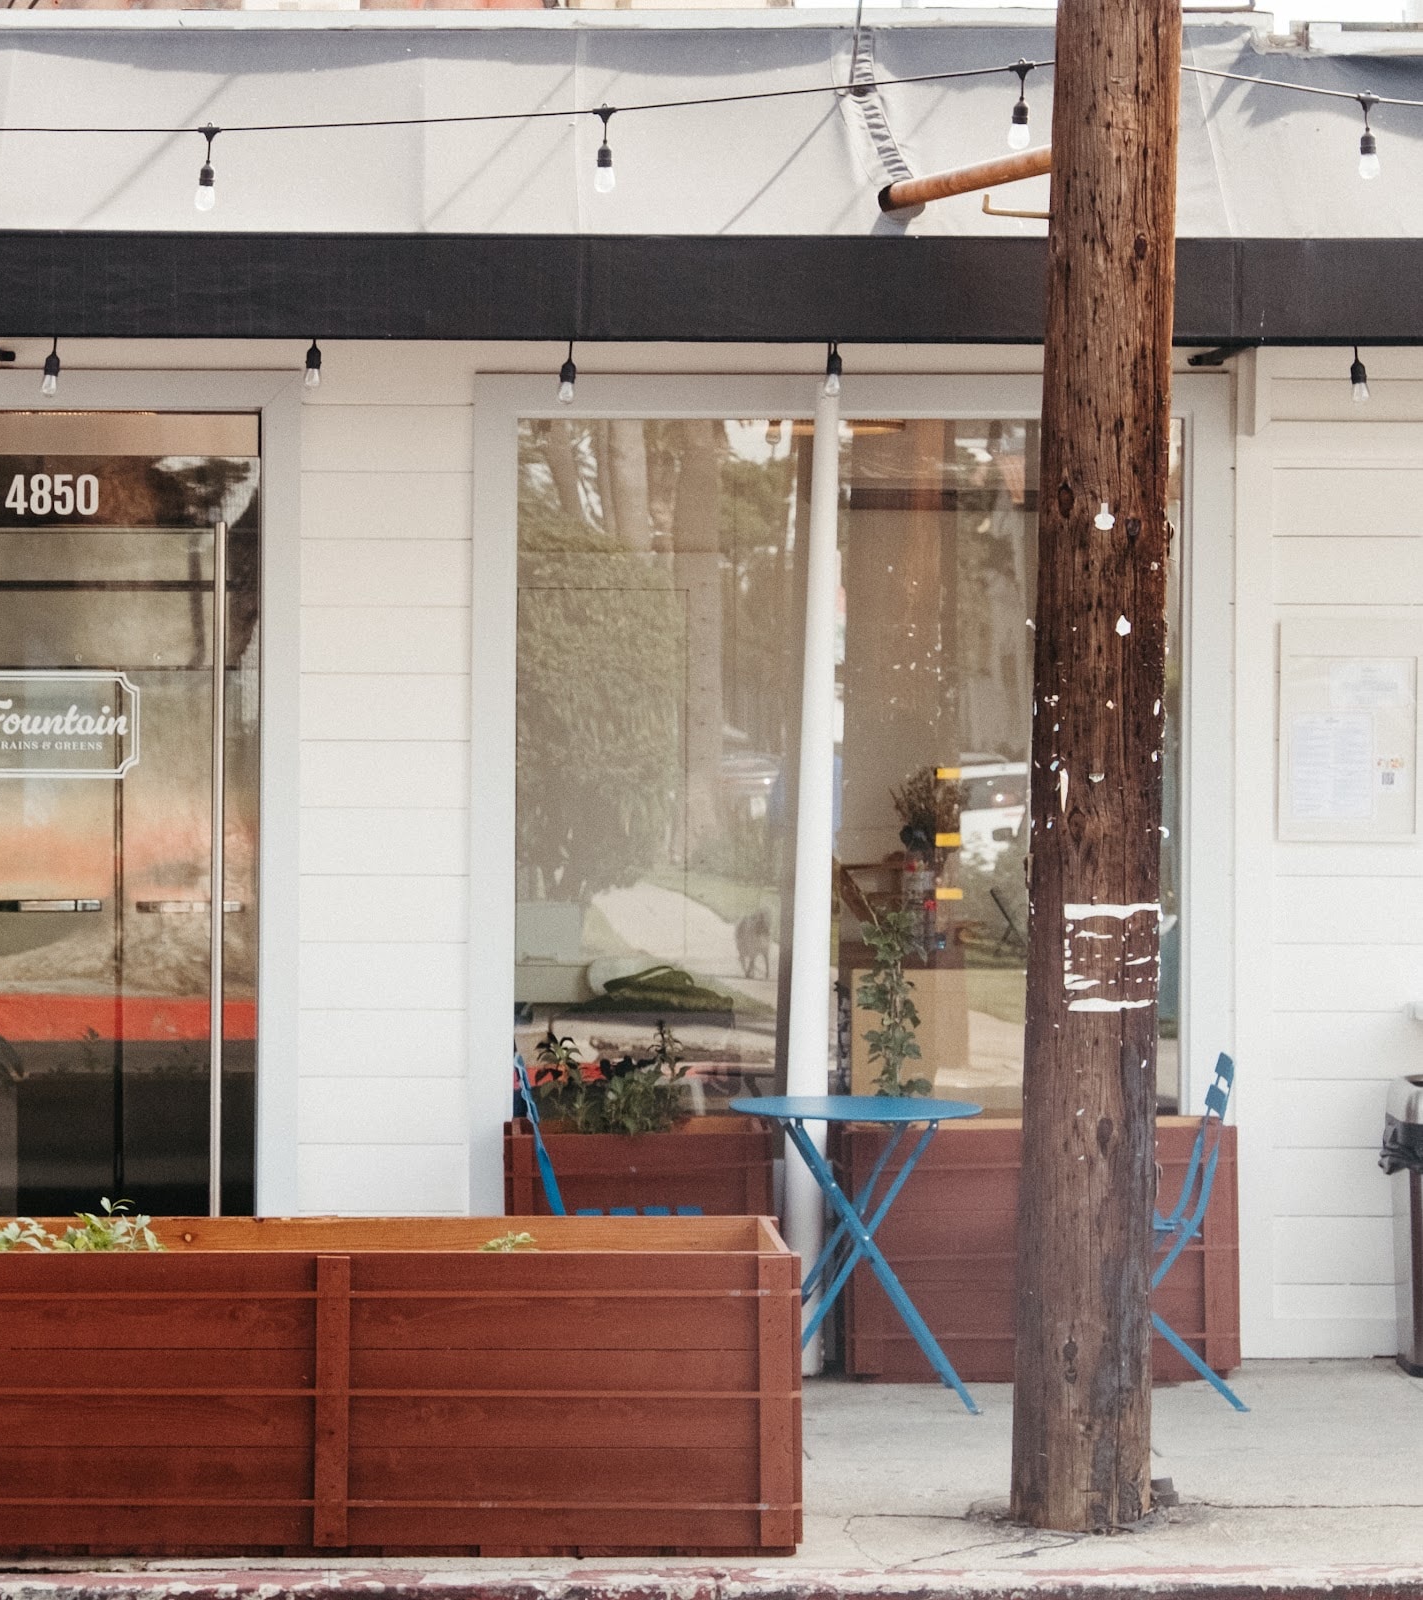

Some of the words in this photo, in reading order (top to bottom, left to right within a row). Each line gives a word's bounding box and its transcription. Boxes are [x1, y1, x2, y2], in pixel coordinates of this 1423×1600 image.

[5, 474, 99, 515] 4850
[41, 740, 52, 750] &
[54, 740, 103, 750] GREENS
